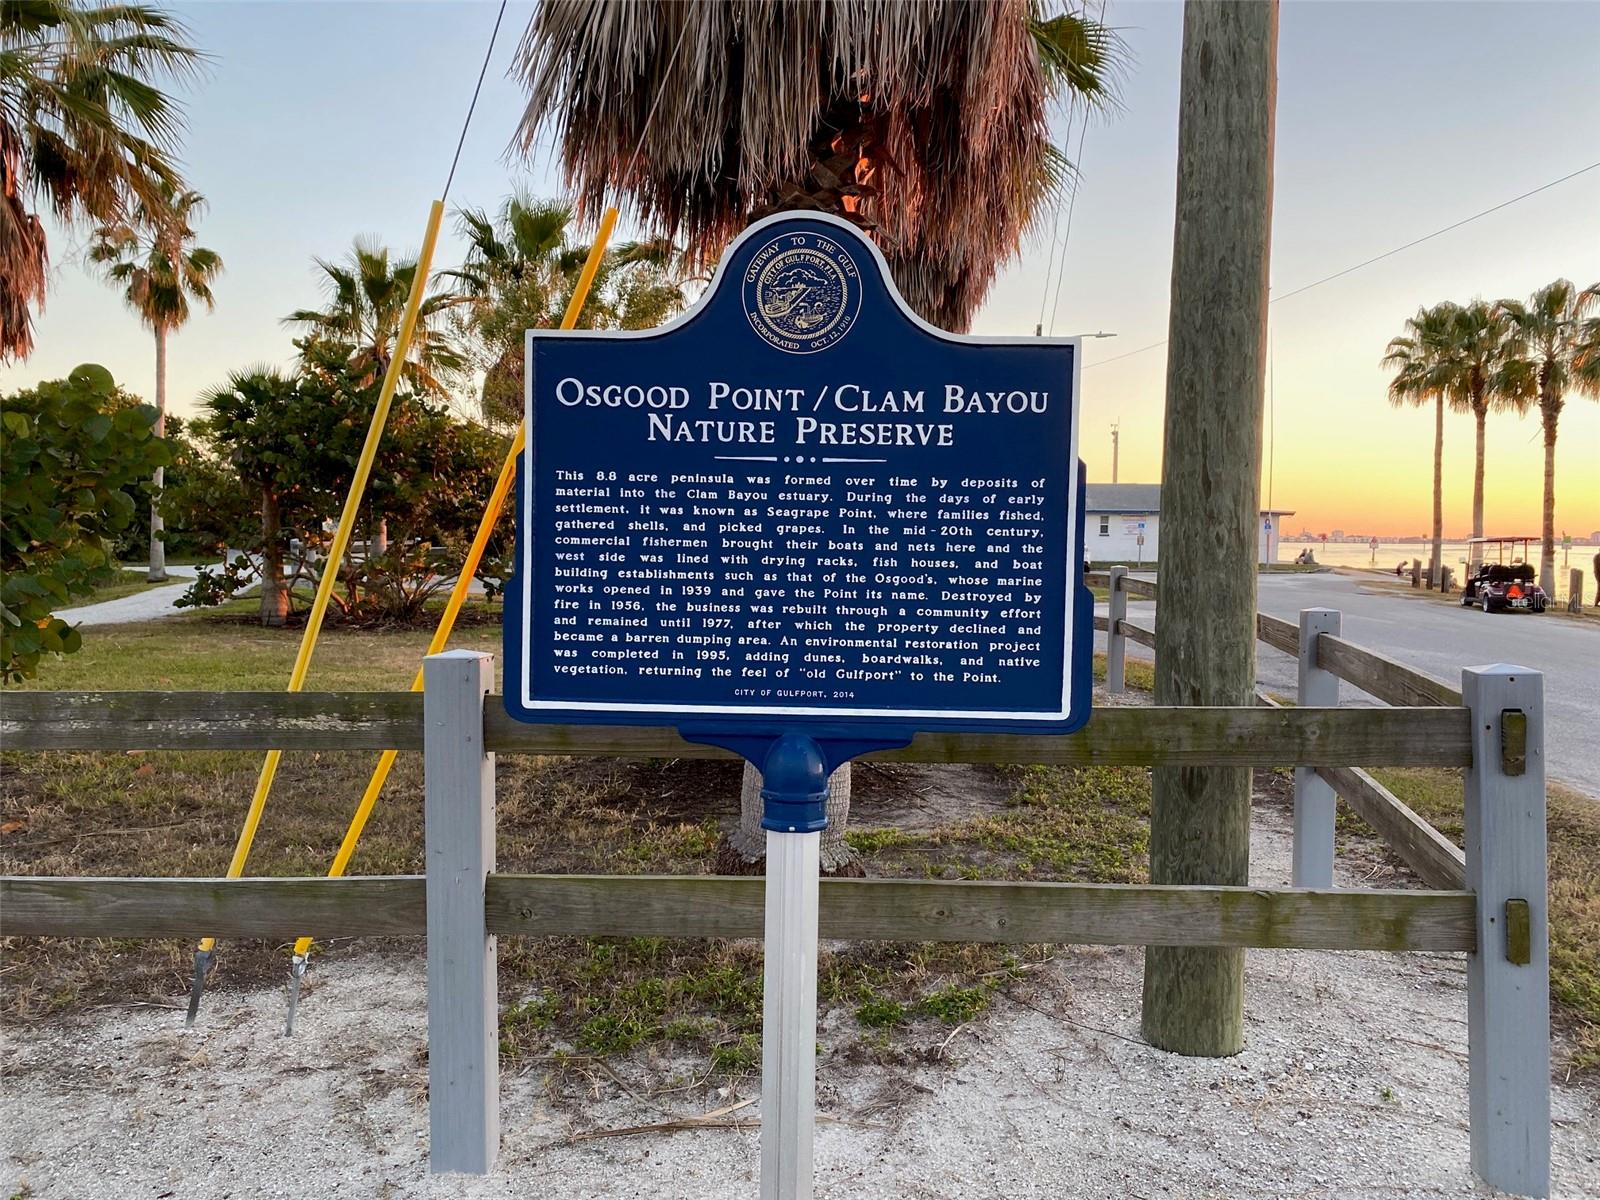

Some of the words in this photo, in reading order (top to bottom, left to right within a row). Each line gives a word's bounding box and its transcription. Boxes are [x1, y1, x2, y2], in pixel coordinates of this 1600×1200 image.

[746, 242, 780, 283] GATEWAY
[791, 237, 806, 246] TO
[816, 239, 836, 254] THE
[838, 254, 857, 278] GULF
[764, 267, 777, 285] CITY
[775, 261, 785, 270] OF
[750, 312, 800, 350] INCORPORATED
[810, 337, 829, 349] OCT.
[829, 331, 841, 340] 12,
[555, 470, 584, 481] This
[596, 470, 617, 481] 8.8
[628, 473, 658, 483] acre
[670, 473, 734, 485] peninsula
[746, 476, 771, 485] was
[784, 474, 831, 486] formed
[845, 477, 876, 487] over
[888, 476, 918, 487] time
[931, 476, 949, 489] by
[960, 477, 1018, 489] deposits
[1030, 477, 1046, 489] of
[555, 486, 610, 497] material
[619, 487, 645, 498] into
[654, 488, 676, 499] the
[686, 489, 718, 500] Clam
[727, 489, 768, 502] Bayou
[778, 491, 833, 504] estuary.
[846, 491, 893, 505] During
[905, 492, 927, 503] the
[938, 493, 970, 506] days
[982, 493, 997, 504] of
[1007, 494, 1045, 506] early
[554, 503, 630, 514] settlement,
[639, 504, 651, 515] it
[658, 506, 684, 515] was
[693, 505, 735, 516] known
[743, 508, 758, 517] as
[766, 506, 830, 520] Seagrape
[838, 507, 877, 519] Point,
[887, 508, 928, 519] where
[937, 509, 990, 520] families
[999, 509, 1044, 522] fished,
[554, 519, 615, 532] gathered
[627, 520, 669, 532] shells,
[682, 521, 706, 532] and
[719, 521, 762, 534] picked
[776, 525, 825, 536] grapes.
[842, 524, 856, 535] In
[868, 524, 890, 535] the
[986, 527, 1044, 539] century,
[554, 535, 631, 546] commercial
[642, 536, 708, 548] fishermen
[721, 537, 774, 552] brought
[785, 539, 819, 550] their
[827, 539, 864, 551] boats
[874, 541, 898, 552] and
[907, 542, 936, 552] nets
[945, 542, 976, 553] here
[986, 543, 1010, 554] and
[1021, 543, 1044, 554] the
[554, 551, 585, 561] west
[598, 551, 626, 562] side
[639, 554, 664, 563] was
[676, 553, 709, 564] lined
[720, 554, 749, 565] with
[761, 555, 806, 569] drying
[816, 556, 858, 568] racks,
[872, 556, 898, 568] fish
[910, 557, 959, 569] houses,
[974, 559, 999, 569] and
[1012, 559, 1043, 570] boat
[554, 566, 608, 581] building
[617, 568, 715, 581] establishments
[724, 571, 754, 581] such
[763, 573, 778, 582] as
[786, 571, 813, 583] that
[822, 572, 837, 583] of
[845, 573, 867, 584] the
[947, 575, 989, 586] whose
[996, 576, 1043, 587] marine
[554, 583, 594, 594] works
[603, 585, 651, 596] opened
[660, 585, 673, 596] in
[682, 585, 712, 596] 1939
[721, 586, 745, 597] and
[754, 589, 786, 600] gave
[794, 588, 815, 598] the
[823, 588, 858, 599] Point
[865, 589, 883, 600] its
[891, 591, 929, 601] name.
[941, 590, 1012, 604] Destroyed
[1024, 592, 1042, 605] by
[553, 598, 580, 610] fire
[588, 599, 602, 610] in
[611, 600, 645, 612] 1956,
[655, 601, 677, 612] the
[686, 601, 741, 613] business
[749, 605, 774, 614] was
[782, 603, 827, 615] rebuilt
[835, 604, 888, 619] through
[898, 607, 906, 616] a
[916, 607, 990, 620] community
[999, 608, 1042, 619] effort
[553, 615, 577, 626] and
[587, 616, 648, 627] remained
[659, 617, 691, 628] until
[702, 617, 734, 630] 1977,
[747, 618, 782, 630] after
[794, 620, 833, 631] which
[844, 620, 866, 632] the
[877, 623, 939, 635] property
[949, 623, 1006, 635] declined
[1017, 625, 1042, 635] and
[553, 630, 604, 642] became
[610, 633, 619, 642] a
[625, 632, 670, 644] barren
[676, 633, 732, 648] dumping
[737, 636, 772, 646] area.
[779, 635, 798, 646] An
[804, 636, 898, 649] environmental
[904, 639, 979, 650] restoration
[989, 641, 1041, 653] project
[553, 649, 578, 658] was
[591, 648, 659, 661] completed
[672, 649, 684, 660] in
[696, 649, 730, 661] 1995,
[744, 651, 790, 664] adding
[803, 652, 846, 664] dunes,
[861, 653, 943, 666] boardwalks,
[959, 656, 984, 666] and
[998, 656, 1041, 667] native
[553, 664, 628, 676] vegetation,
[638, 665, 702, 679] returning
[711, 666, 732, 677] the
[741, 666, 767, 678] feel
[775, 667, 790, 678] of
[910, 671, 924, 681] to
[933, 671, 955, 682] the
[962, 671, 1001, 683] Point.
[734, 688, 756, 696] CITY
[760, 689, 772, 697] OF
[776, 689, 827, 699] GULFPORT,
[832, 690, 855, 699] 2014
